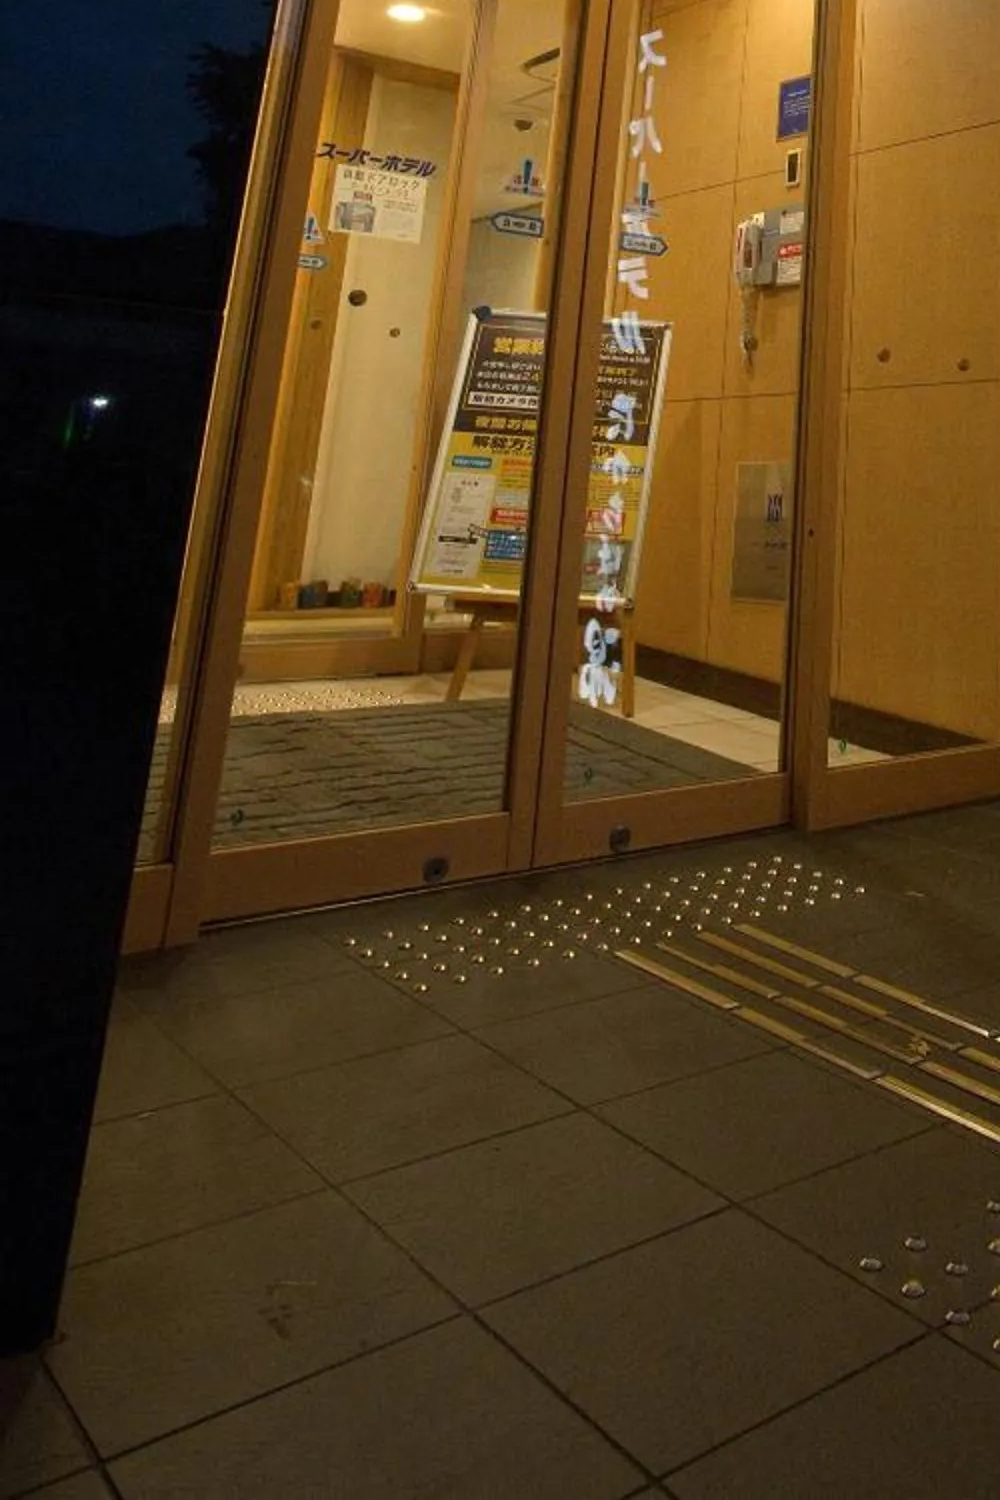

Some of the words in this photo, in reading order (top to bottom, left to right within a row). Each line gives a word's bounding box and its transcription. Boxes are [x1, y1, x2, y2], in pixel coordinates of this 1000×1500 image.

[317, 142, 437, 177] スーパーホテル
